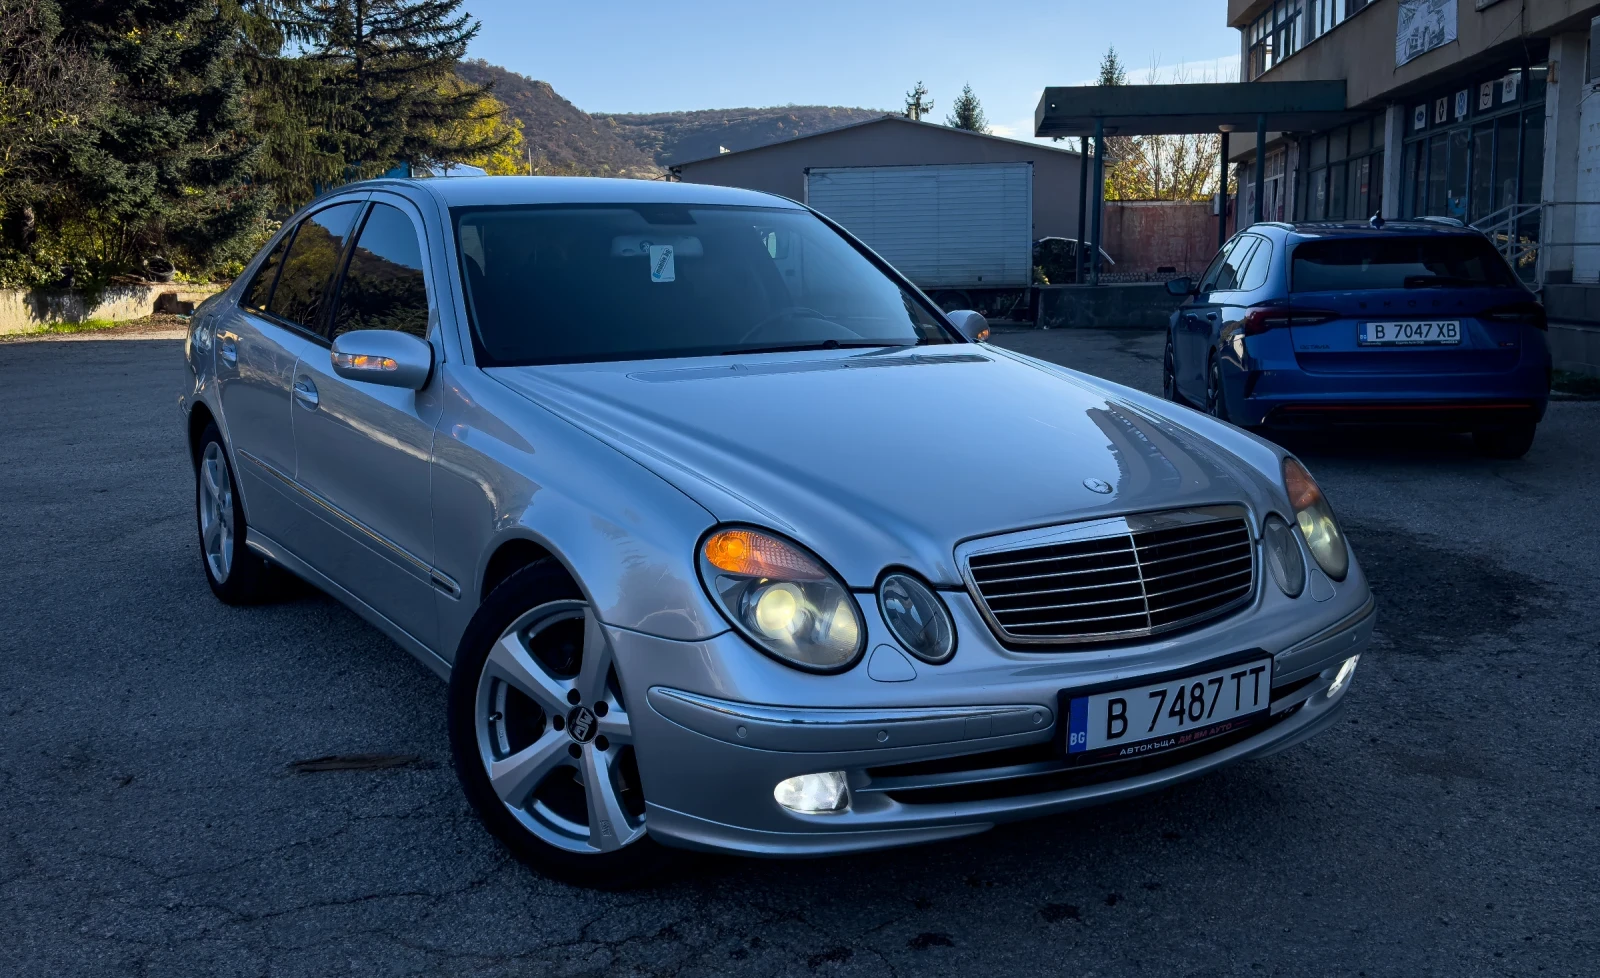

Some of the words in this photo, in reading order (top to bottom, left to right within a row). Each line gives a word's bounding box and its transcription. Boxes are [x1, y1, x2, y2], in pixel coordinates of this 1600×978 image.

[1375, 325, 1385, 339] B
[1394, 324, 1432, 339] 7047
[1436, 323, 1457, 338] XB
[1106, 697, 1128, 740] B
[1147, 676, 1224, 732] 7487
[1230, 665, 1266, 711] TT
[1069, 731, 1086, 746] BG
[1119, 738, 1176, 756] АВТОКЪЩА
[1208, 722, 1233, 736] АУТО
